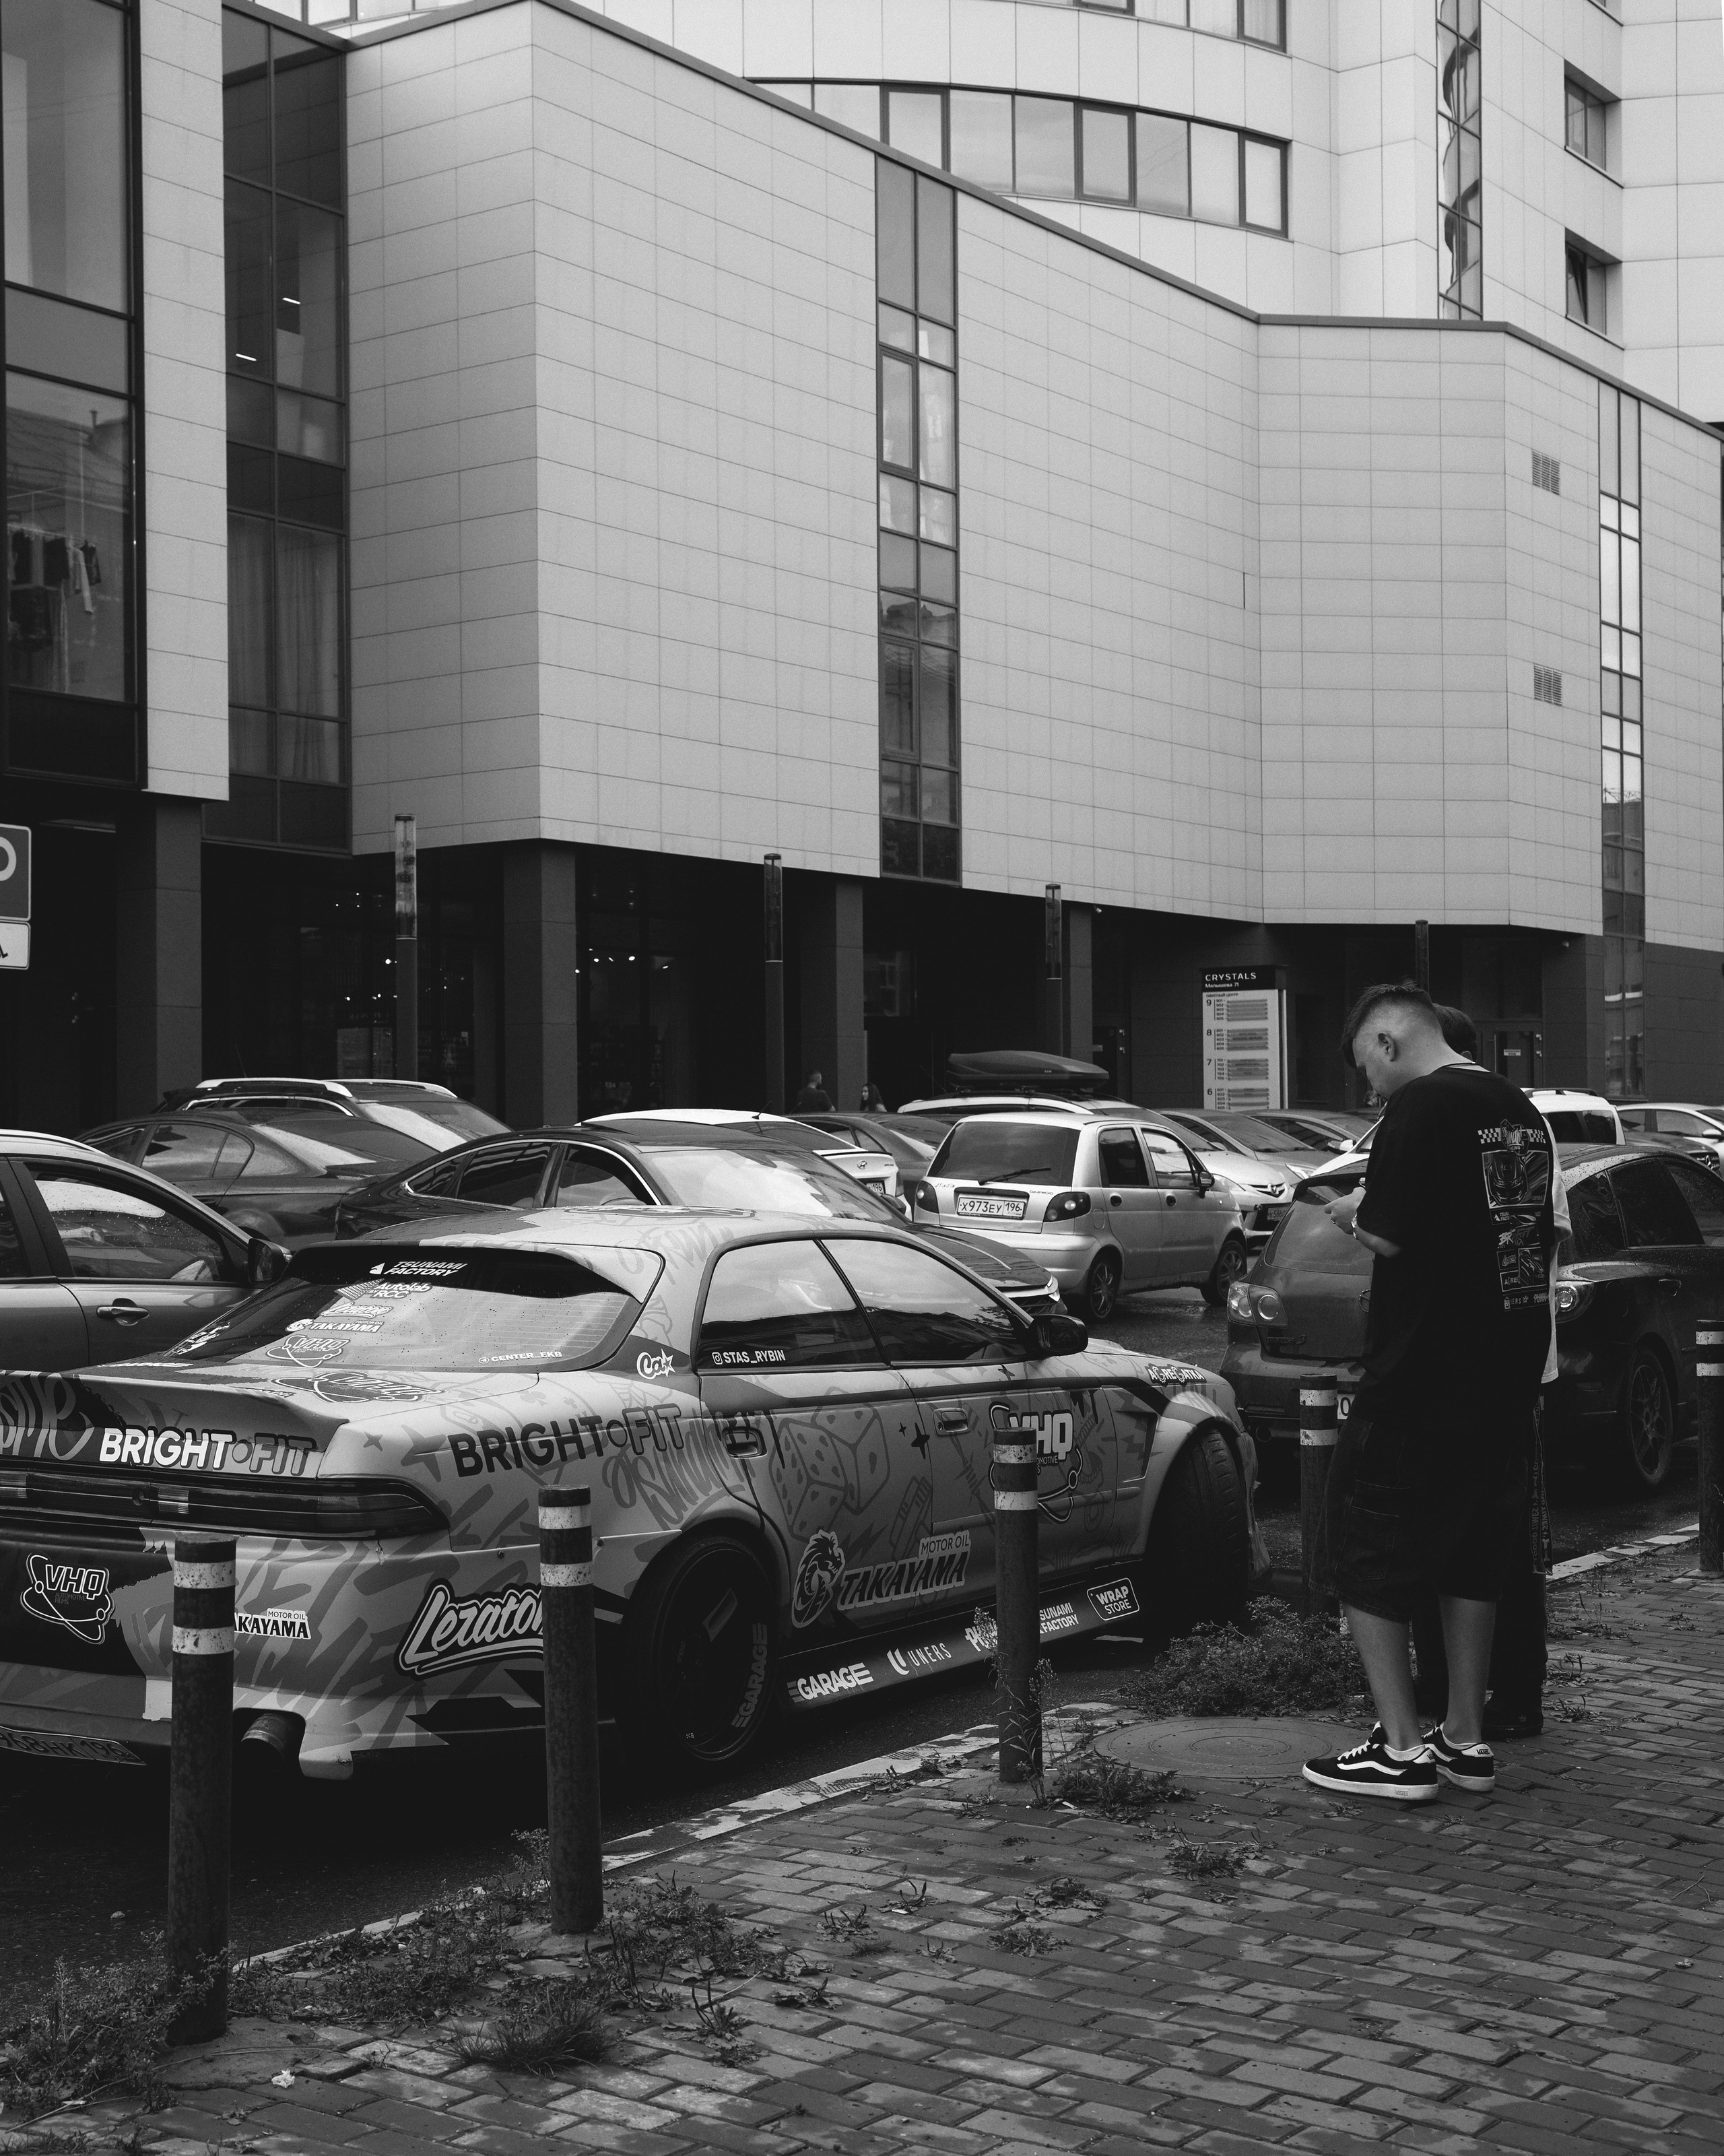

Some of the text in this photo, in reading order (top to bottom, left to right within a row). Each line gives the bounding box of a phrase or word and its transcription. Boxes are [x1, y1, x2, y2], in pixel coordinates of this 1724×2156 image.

[1205, 972, 1257, 981] CRYSTALS
[1005, 1202, 1020, 1212] 196
[383, 1268, 459, 1276] FACTORY
[394, 1261, 468, 1270] TSUNAMI
[372, 1290, 409, 1298] RCC
[373, 1282, 431, 1292] Autolab
[310, 1322, 380, 1332] TAKAYAMA
[292, 1338, 350, 1351] VHQ
[1267, 1334, 1307, 1345] mazda 3
[490, 1351, 562, 1362] CENTER_EKB
[723, 1349, 786, 1364] STAS_RYBIN
[1148, 1366, 1205, 1383] AGREGATKA
[622, 1403, 684, 1456] FIT
[248, 1432, 317, 1476] FIT
[921, 1534, 969, 1555] MOTOR OIL
[45, 1564, 106, 1600] VHQ
[840, 1551, 968, 1606] TAKAYAMA
[55, 1592, 86, 1602] AUTOMOTIVE
[1096, 1585, 1129, 1606] WRAP
[268, 1610, 292, 1619] MOTOR
[1039, 1602, 1073, 1621] SUNAMI
[1104, 1598, 1132, 1615] STORE
[234, 1615, 309, 1639] KAYAMA
[1042, 1613, 1080, 1633] FACTORY
[907, 1642, 952, 1667] UNERS
[797, 1662, 874, 1700] GARAGE
